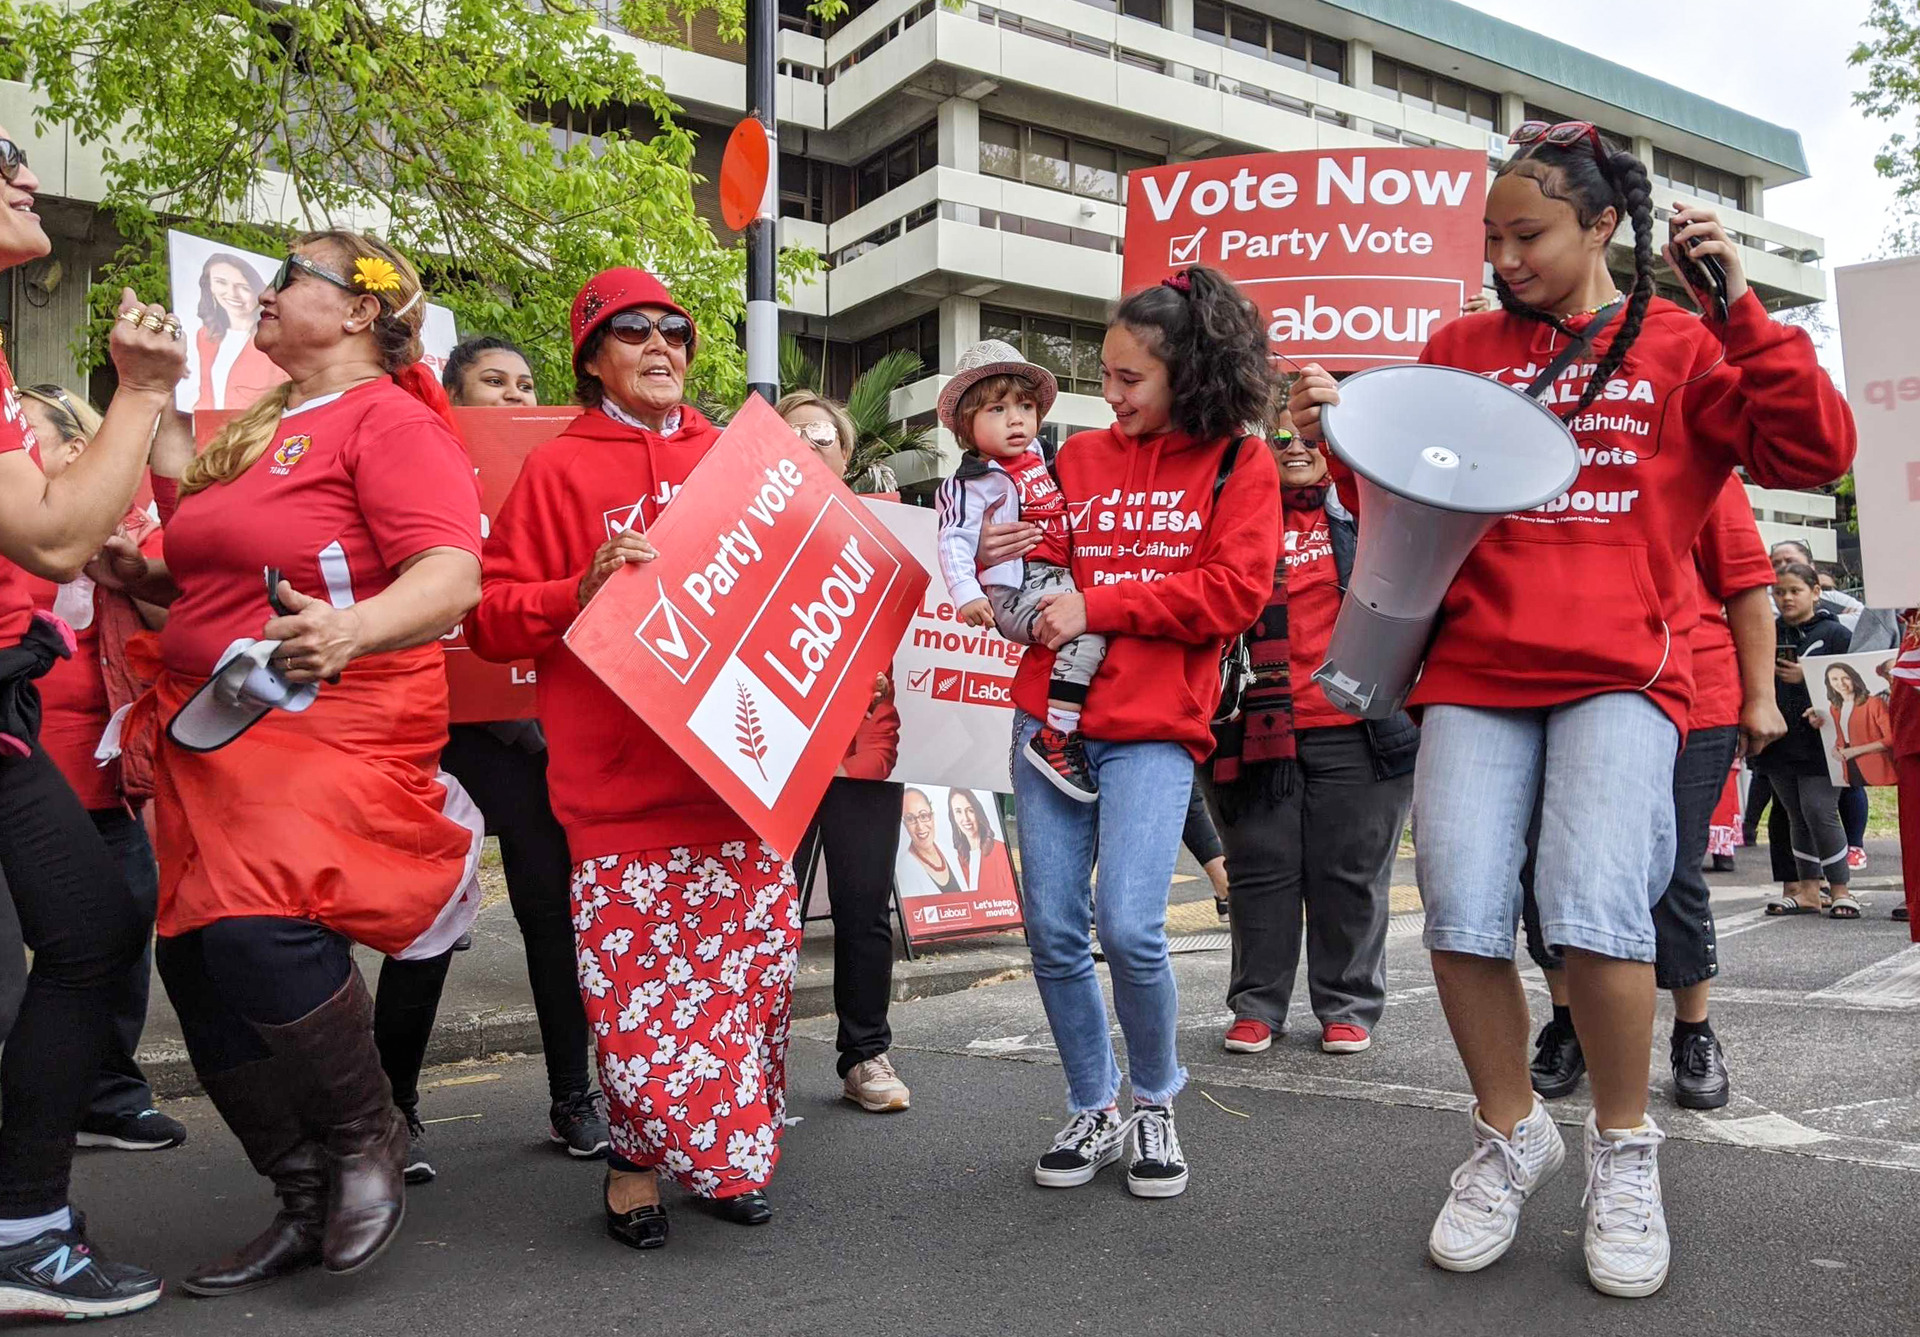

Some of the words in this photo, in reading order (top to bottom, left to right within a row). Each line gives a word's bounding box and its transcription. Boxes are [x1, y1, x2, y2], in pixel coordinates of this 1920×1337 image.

[1141, 168, 1298, 222] Vote
[1316, 156, 1472, 206] Now
[1220, 227, 1329, 261] Party
[1338, 223, 1433, 255] Vote
[1267, 295, 1441, 343] abour
[1570, 413, 1650, 436] tāhuhu
[1580, 447, 1638, 466] Vote
[1529, 489, 1639, 513] bour
[1098, 510, 1203, 532] SALESA
[682, 519, 764, 618] Party
[747, 458, 804, 527] vote
[764, 535, 876, 698] Labour
[914, 628, 1022, 667] moving
[968, 680, 1011, 702] Labo
[939, 907, 968, 919] Labour
[973, 899, 993, 910] Let's
[993, 898, 1012, 908] keep
[985, 907, 1015, 918] moving
